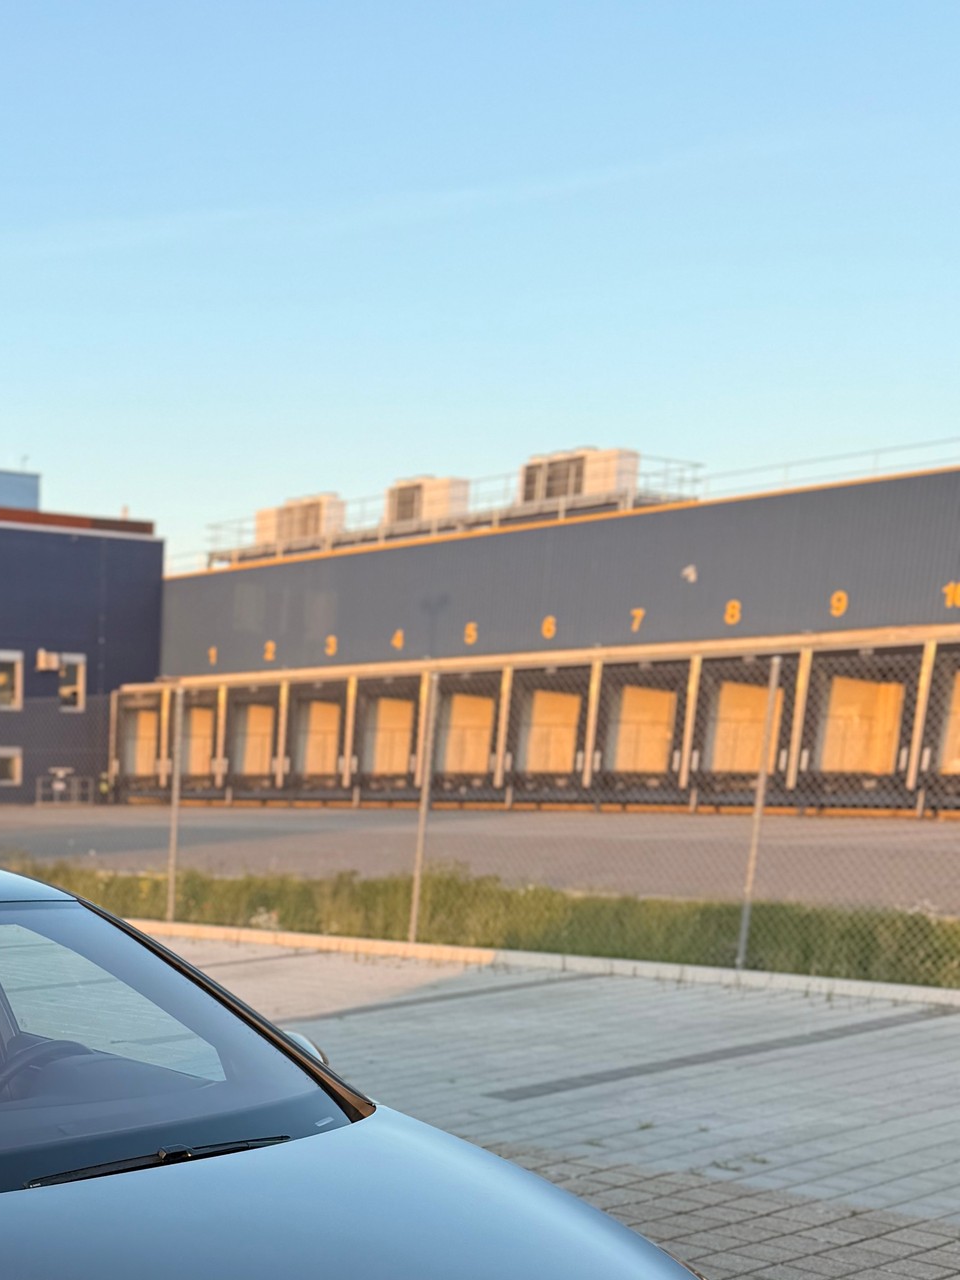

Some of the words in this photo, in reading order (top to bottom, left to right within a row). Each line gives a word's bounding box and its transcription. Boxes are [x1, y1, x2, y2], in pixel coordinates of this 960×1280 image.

[723, 599, 741, 626] 8
[829, 590, 848, 618] 9
[541, 615, 556, 640] 6
[630, 607, 646, 633] 7
[391, 629, 404, 650] 4
[463, 622, 478, 645] 5
[208, 646, 218, 666] 1
[263, 640, 276, 662] 2
[325, 635, 338, 656] 3
